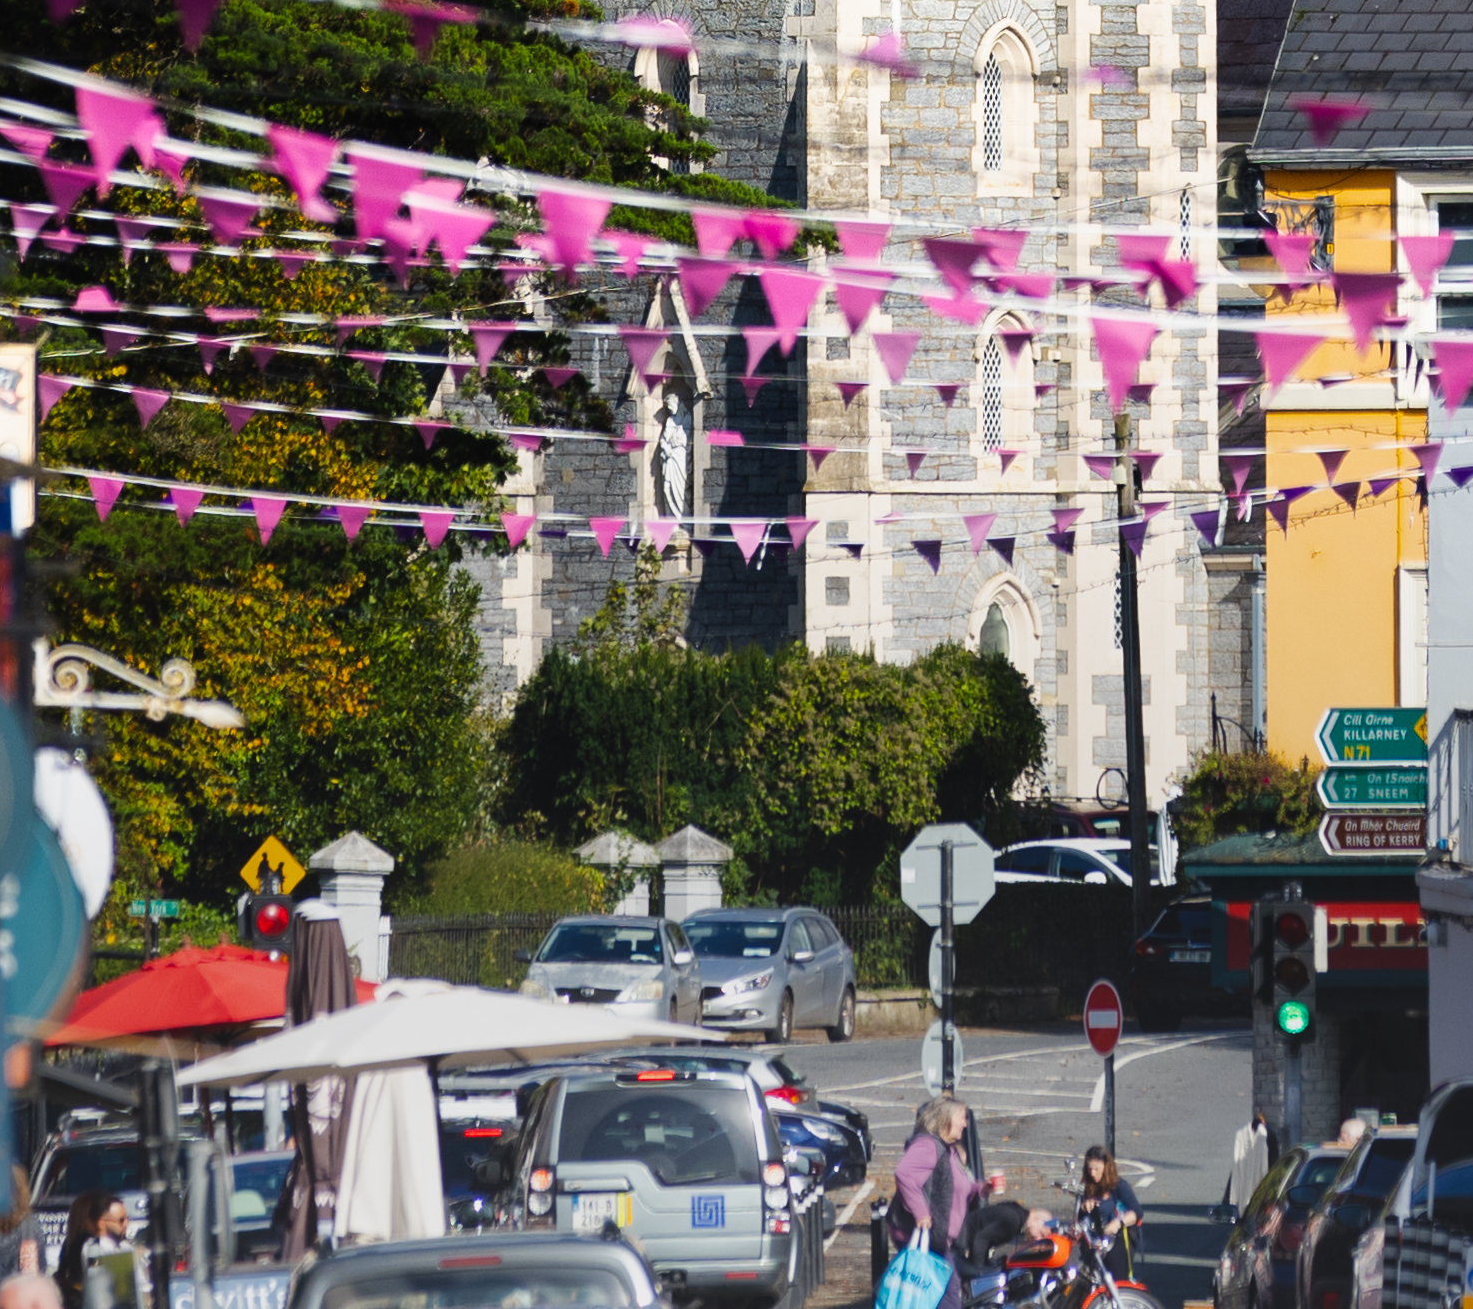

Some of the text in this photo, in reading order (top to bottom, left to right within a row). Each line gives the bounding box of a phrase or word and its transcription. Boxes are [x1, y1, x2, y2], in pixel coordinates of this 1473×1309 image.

[1343, 713, 1362, 726] Cill
[1344, 729, 1407, 741] KILLARNEY
[1344, 787, 1409, 800] 27 SNEEM
[1345, 835, 1421, 847] RING OF KERRY
[174, 1278, 287, 1309] dvitt's
